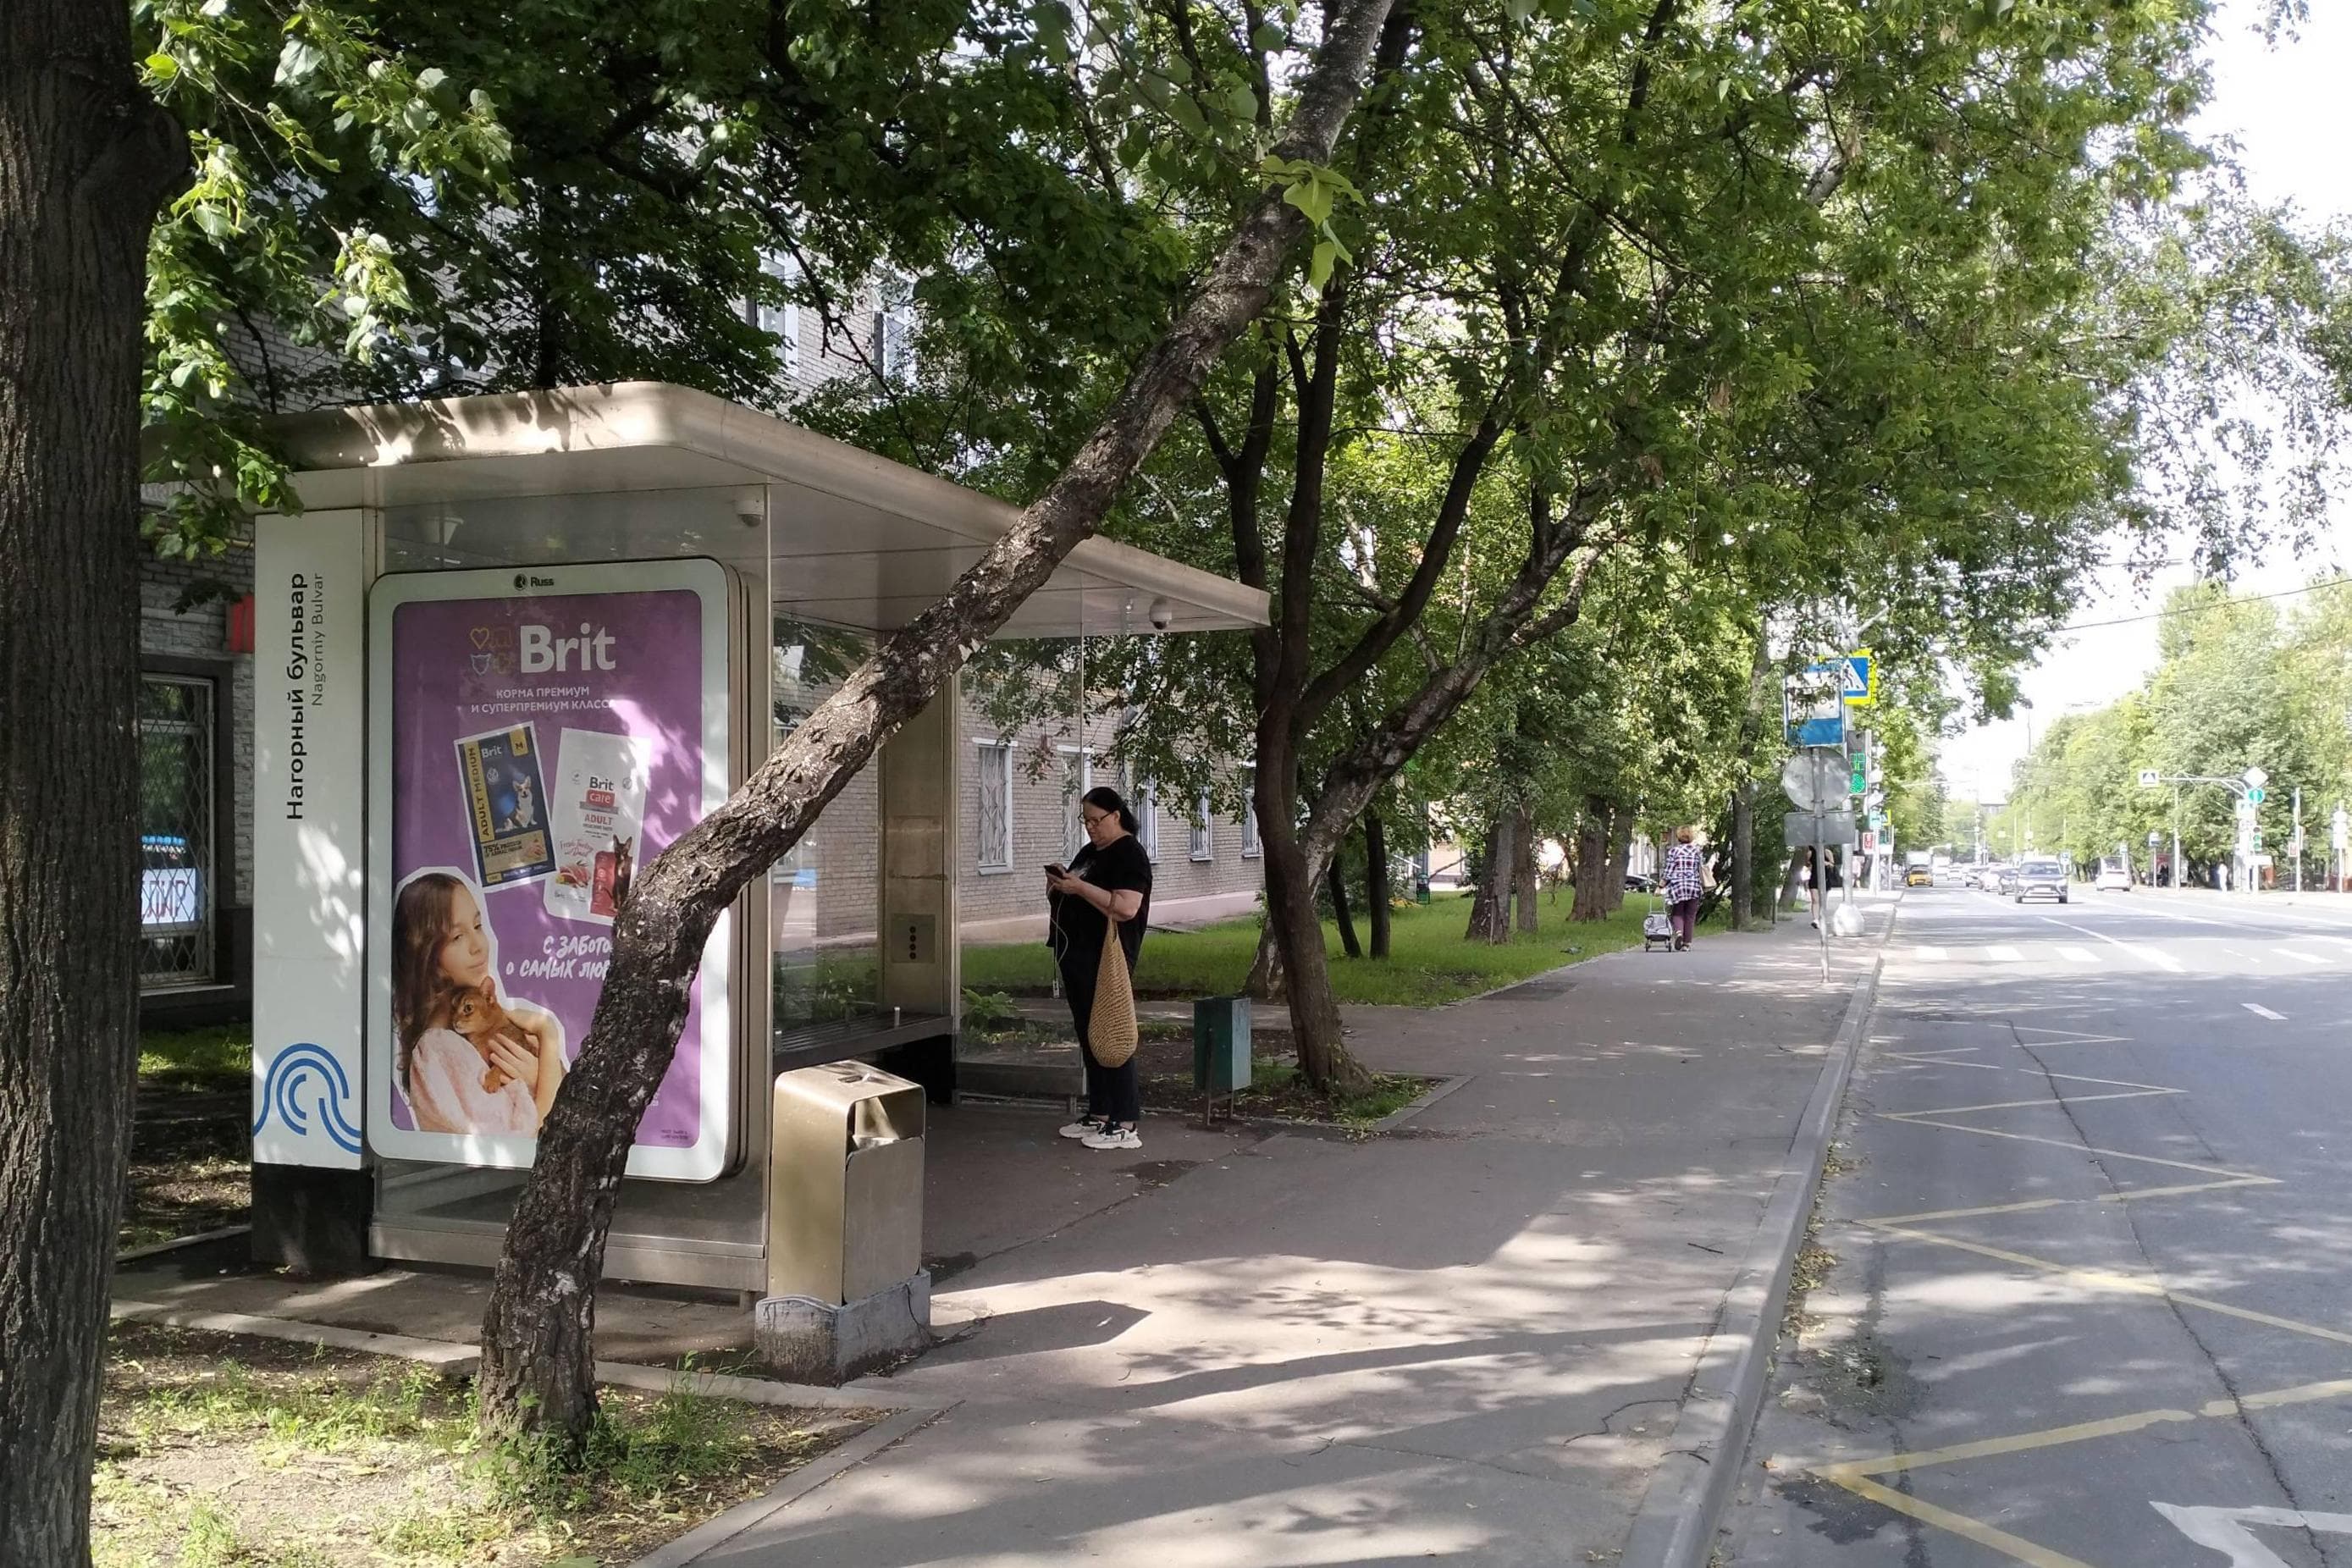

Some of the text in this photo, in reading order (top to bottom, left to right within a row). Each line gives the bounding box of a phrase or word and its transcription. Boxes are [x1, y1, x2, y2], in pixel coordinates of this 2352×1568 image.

[530, 577, 555, 587] Russ
[310, 573, 326, 706] Nagorniy Bulvar
[520, 622, 616, 673] Brit
[286, 574, 306, 820] Нагорный бульвар
[496, 687, 590, 698] КОРМА ПРЕМИУМ
[471, 704, 479, 713] И
[482, 700, 569, 715] СУПЕРПРЕМИУМ
[481, 745, 502, 758] Brit
[589, 776, 614, 791] Brit
[468, 747, 489, 836] ADULT MEDIUM
[589, 792, 611, 803] care
[584, 814, 614, 825] ADULT
[543, 935, 612, 958] С ЗАБОТО
[519, 957, 577, 980] САМЫХ
